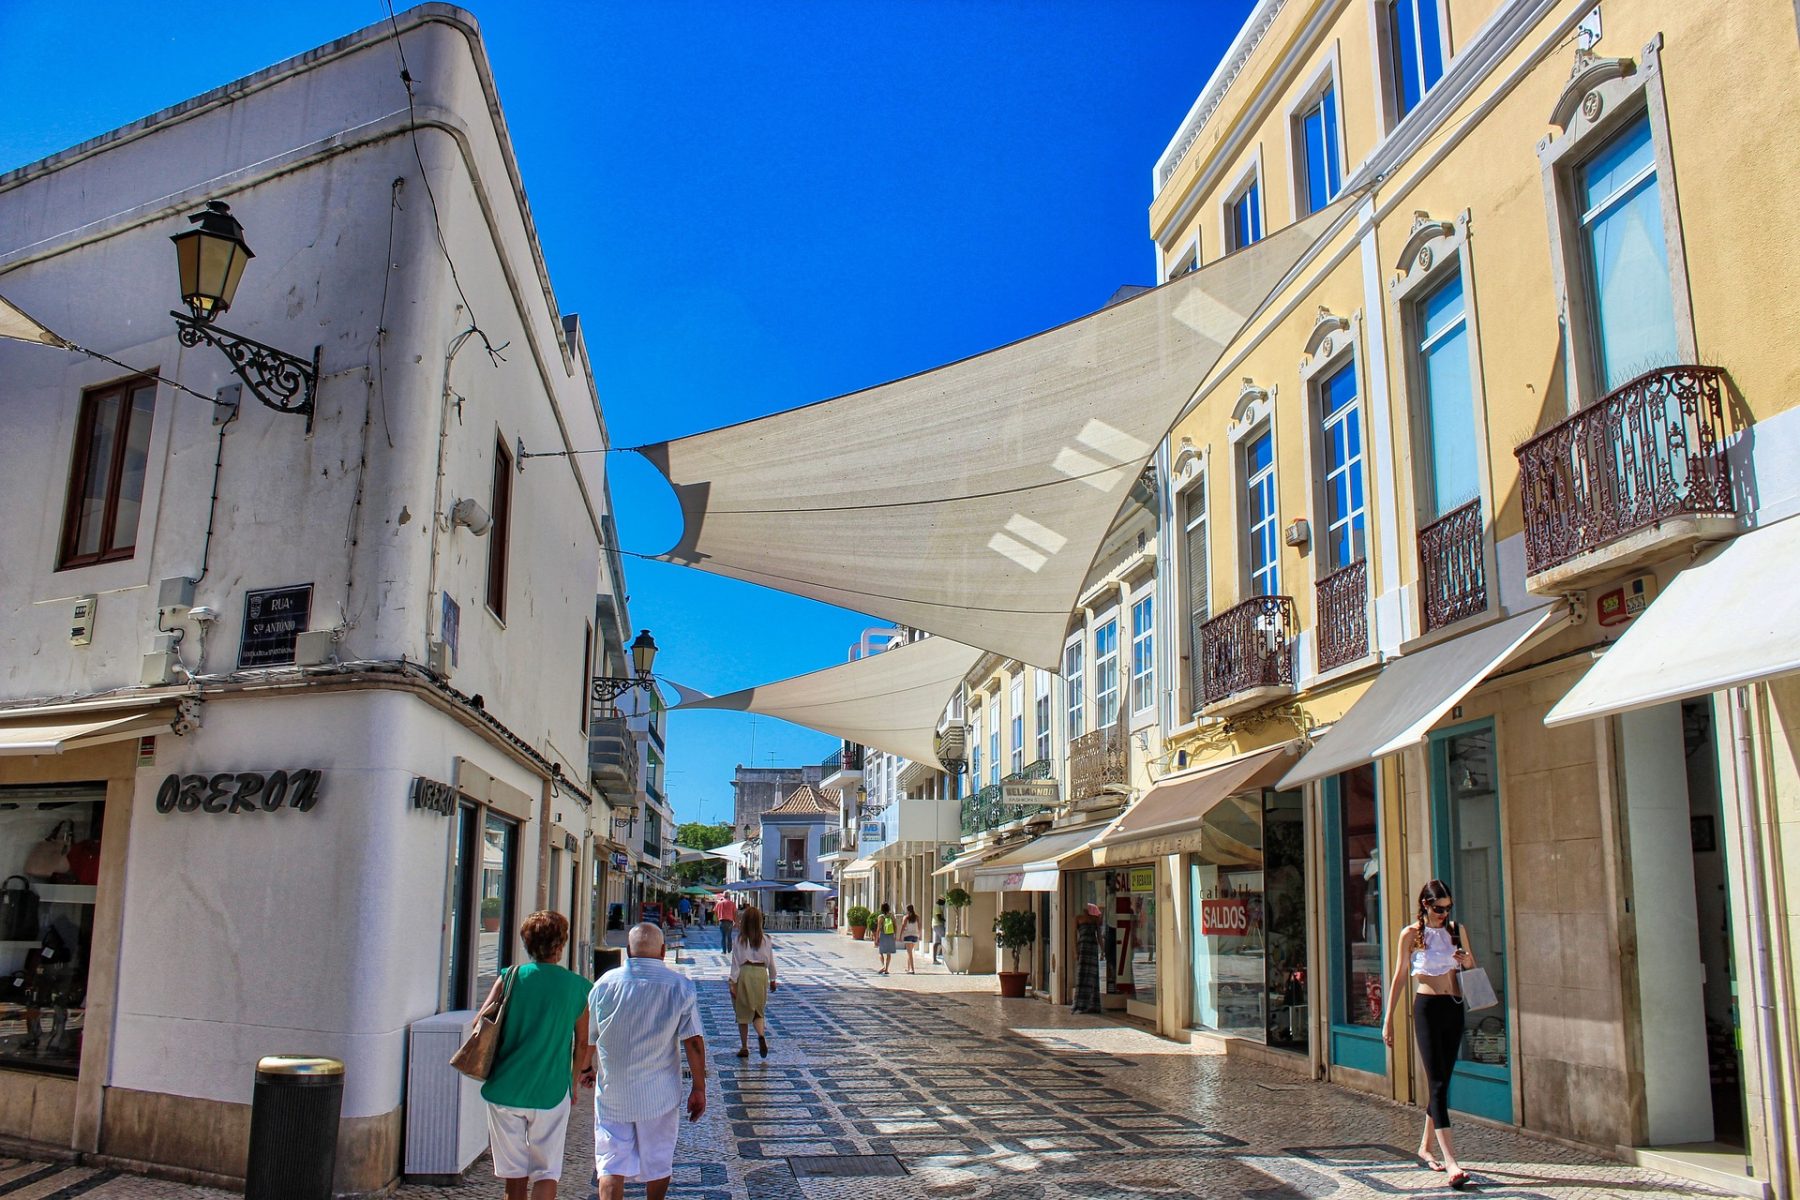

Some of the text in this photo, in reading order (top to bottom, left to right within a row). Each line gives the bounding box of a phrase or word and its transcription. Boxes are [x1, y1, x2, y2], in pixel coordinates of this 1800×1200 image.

[156, 769, 322, 814] OBERON
[414, 777, 455, 816] OBERO
[1203, 905, 1247, 929] SALDOS
